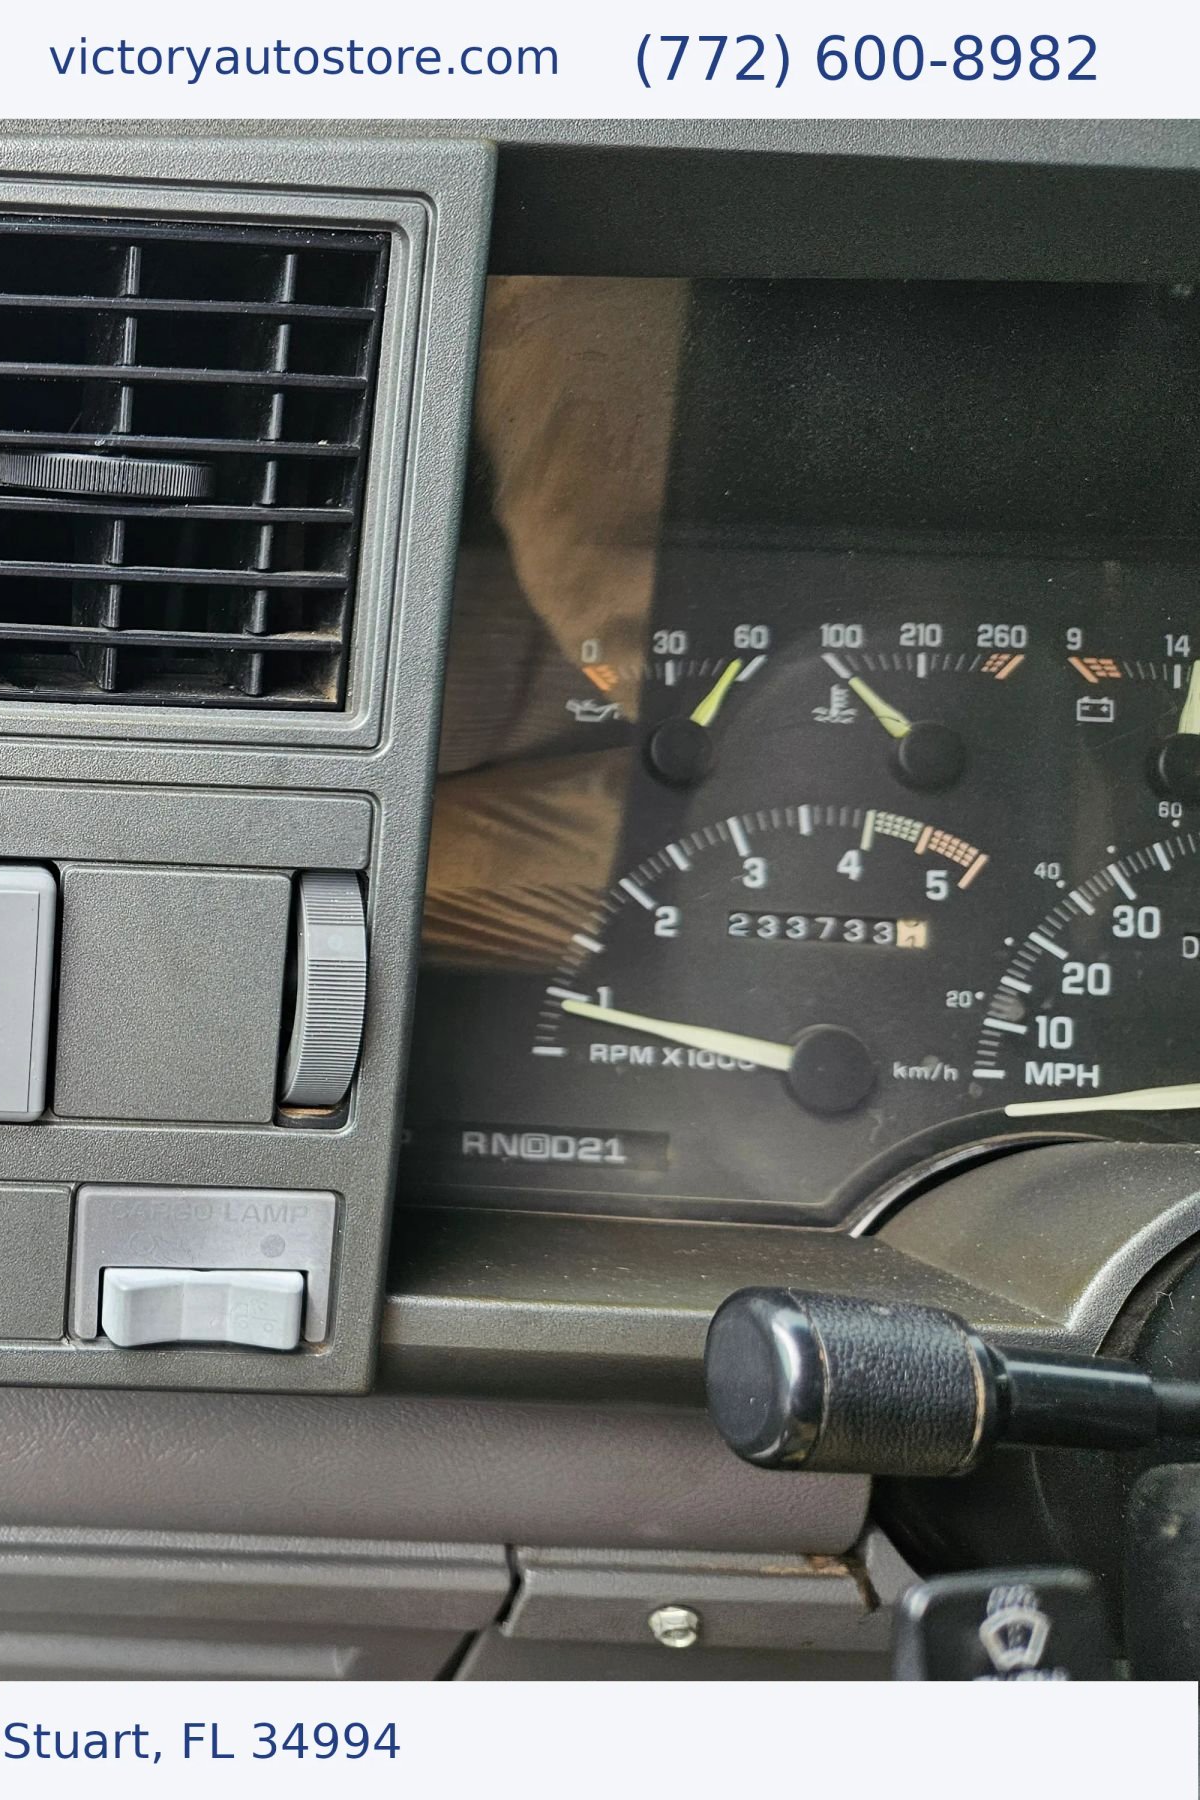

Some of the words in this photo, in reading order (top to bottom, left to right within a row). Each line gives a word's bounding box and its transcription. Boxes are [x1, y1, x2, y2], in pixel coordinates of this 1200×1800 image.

[653, 629, 687, 655] 30
[734, 624, 769, 649] 60
[819, 623, 862, 648] 100
[900, 623, 942, 647] 210
[977, 624, 1026, 648] 260
[1066, 627, 1082, 650] 9
[1165, 634, 1190, 657] 14
[581, 638, 598, 663] 0
[1158, 801, 1182, 818] 60
[742, 857, 767, 888] 3
[836, 850, 862, 880] 4
[1034, 862, 1060, 880] 40
[925, 870, 948, 900] 5
[654, 906, 680, 937] 2
[1112, 905, 1161, 939] 30
[1062, 962, 1111, 996] 20
[597, 986, 612, 1009] 1
[946, 990, 973, 1008] 20
[1035, 1015, 1073, 1049] 10
[590, 1043, 654, 1067] RPM
[892, 1060, 959, 1082] km/h
[1025, 1061, 1099, 1088] MPH
[224, 1202, 310, 1224] LAMP
